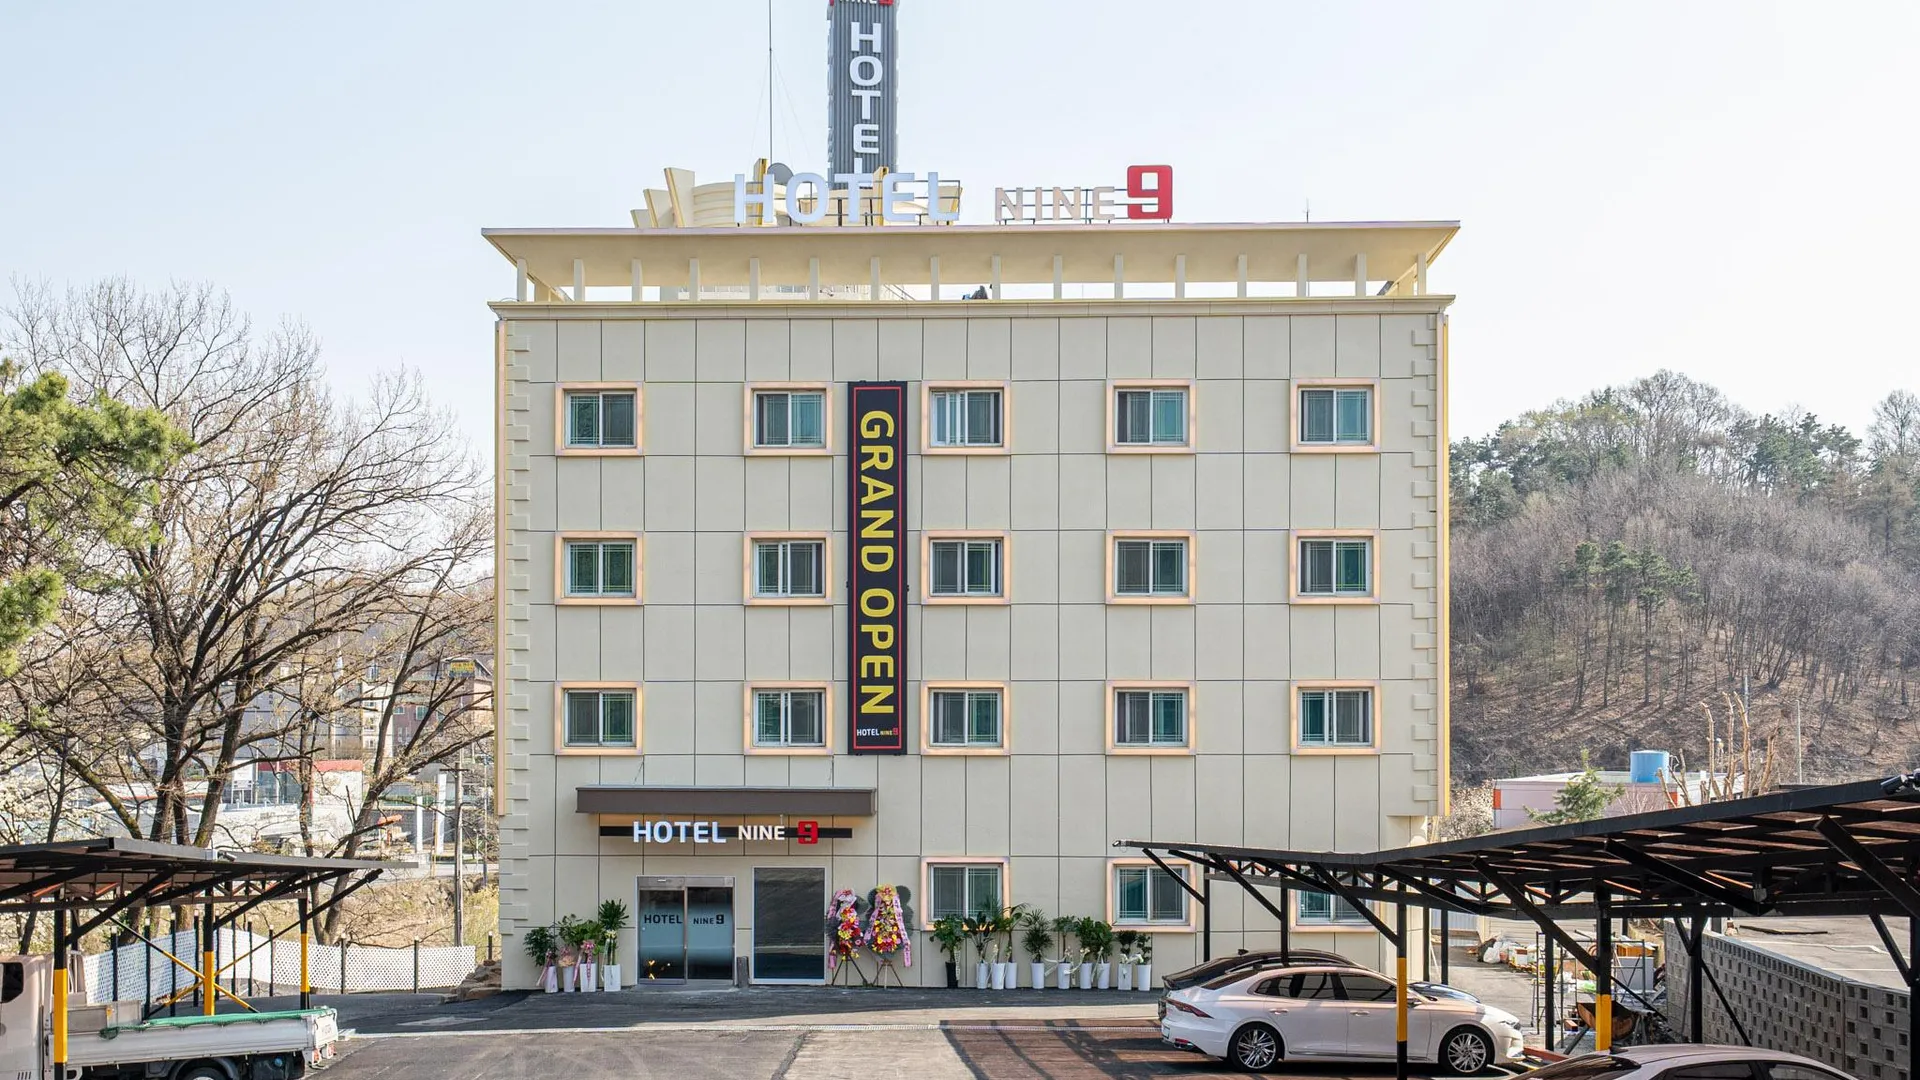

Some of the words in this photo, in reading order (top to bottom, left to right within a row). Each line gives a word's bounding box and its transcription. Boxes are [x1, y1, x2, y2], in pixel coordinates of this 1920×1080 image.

[849, 21, 883, 187] HOTEL
[734, 171, 960, 223] HOTEL
[995, 186, 1116, 221] NINE
[1127, 165, 1173, 219] 9
[860, 410, 895, 573] GRAND
[860, 588, 895, 714] OPEN
[856, 728, 880, 737] HOTEL
[633, 820, 727, 844] HOTEL
[738, 825, 785, 841] NINE
[797, 820, 818, 844] 9
[644, 914, 683, 924] HOTEL
